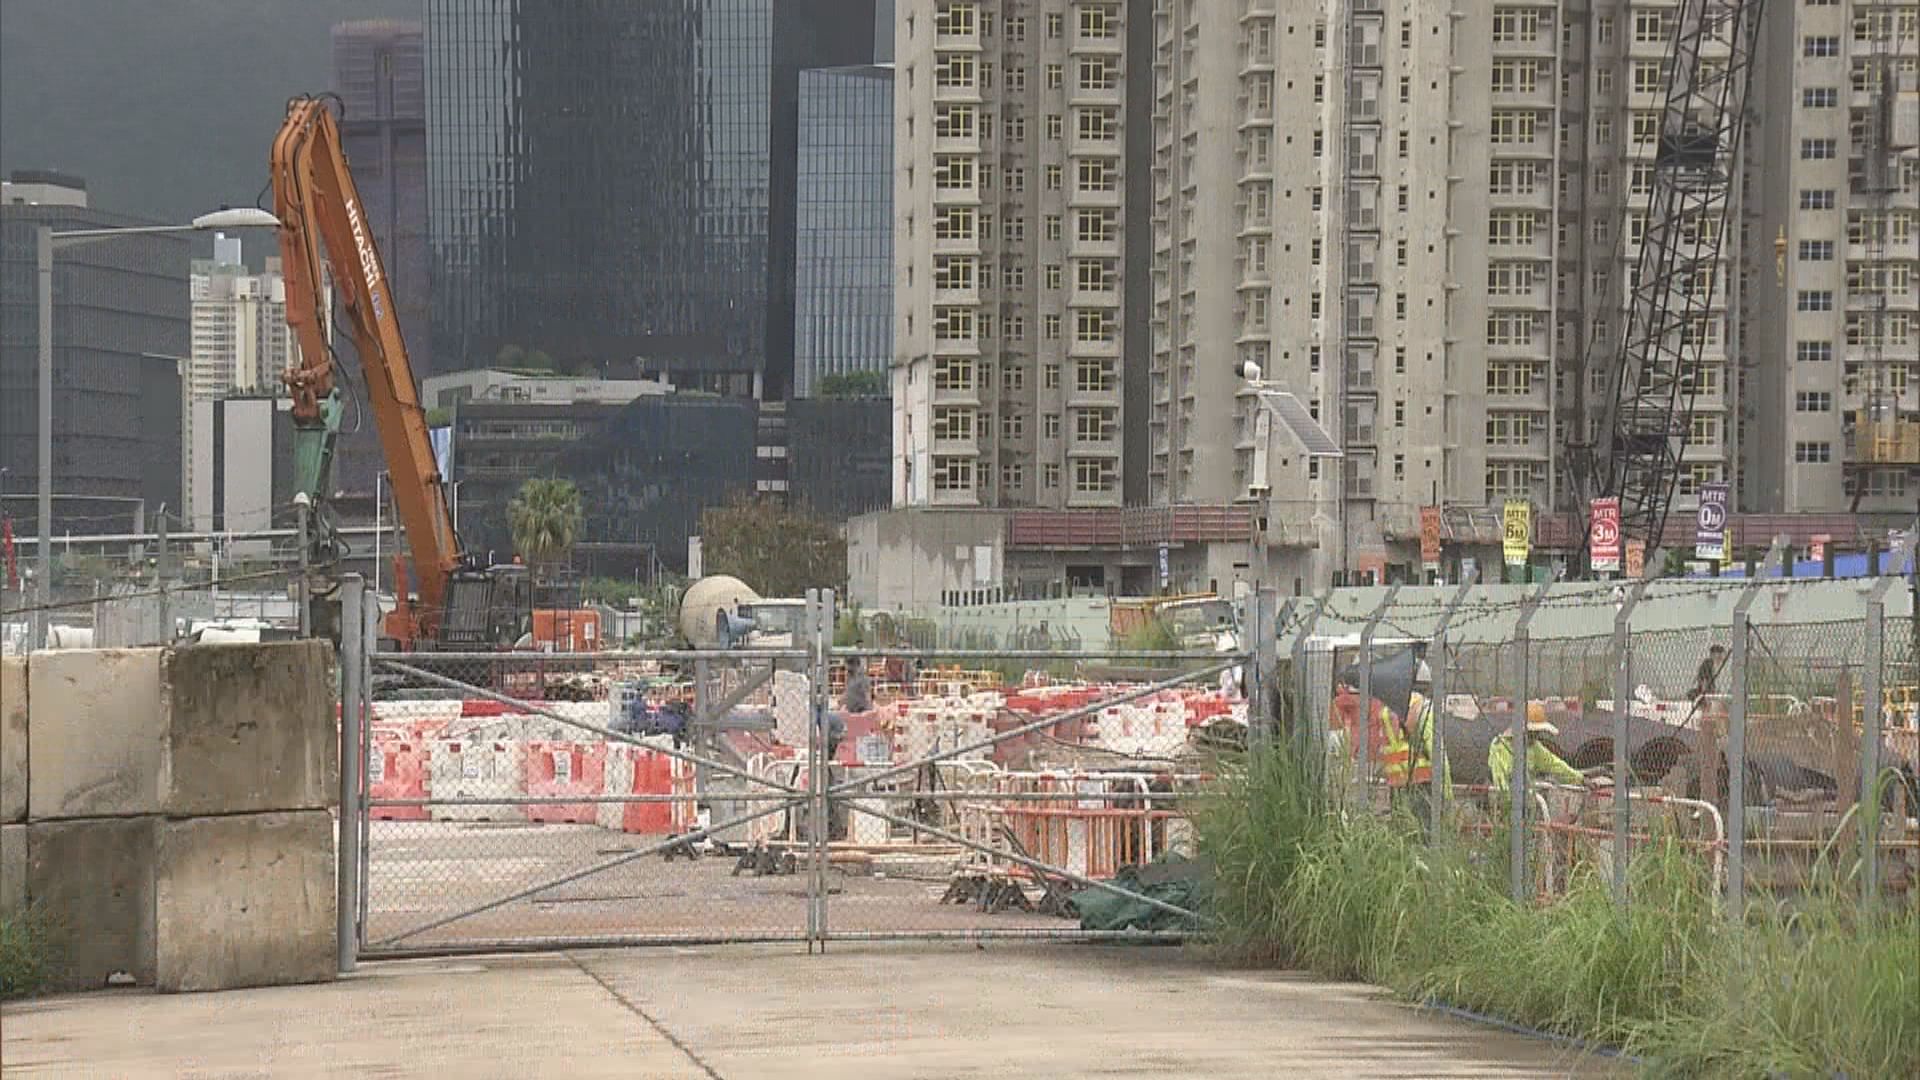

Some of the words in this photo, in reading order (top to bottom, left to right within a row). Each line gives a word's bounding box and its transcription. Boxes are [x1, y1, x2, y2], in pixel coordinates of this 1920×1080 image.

[345, 198, 377, 290] HITACHI
[1702, 490, 1726, 501] MTR
[1506, 510, 1527, 519] MTR
[1593, 508, 1616, 519] MTR
[1701, 508, 1721, 525] 0M
[1594, 525, 1614, 540] 3M
